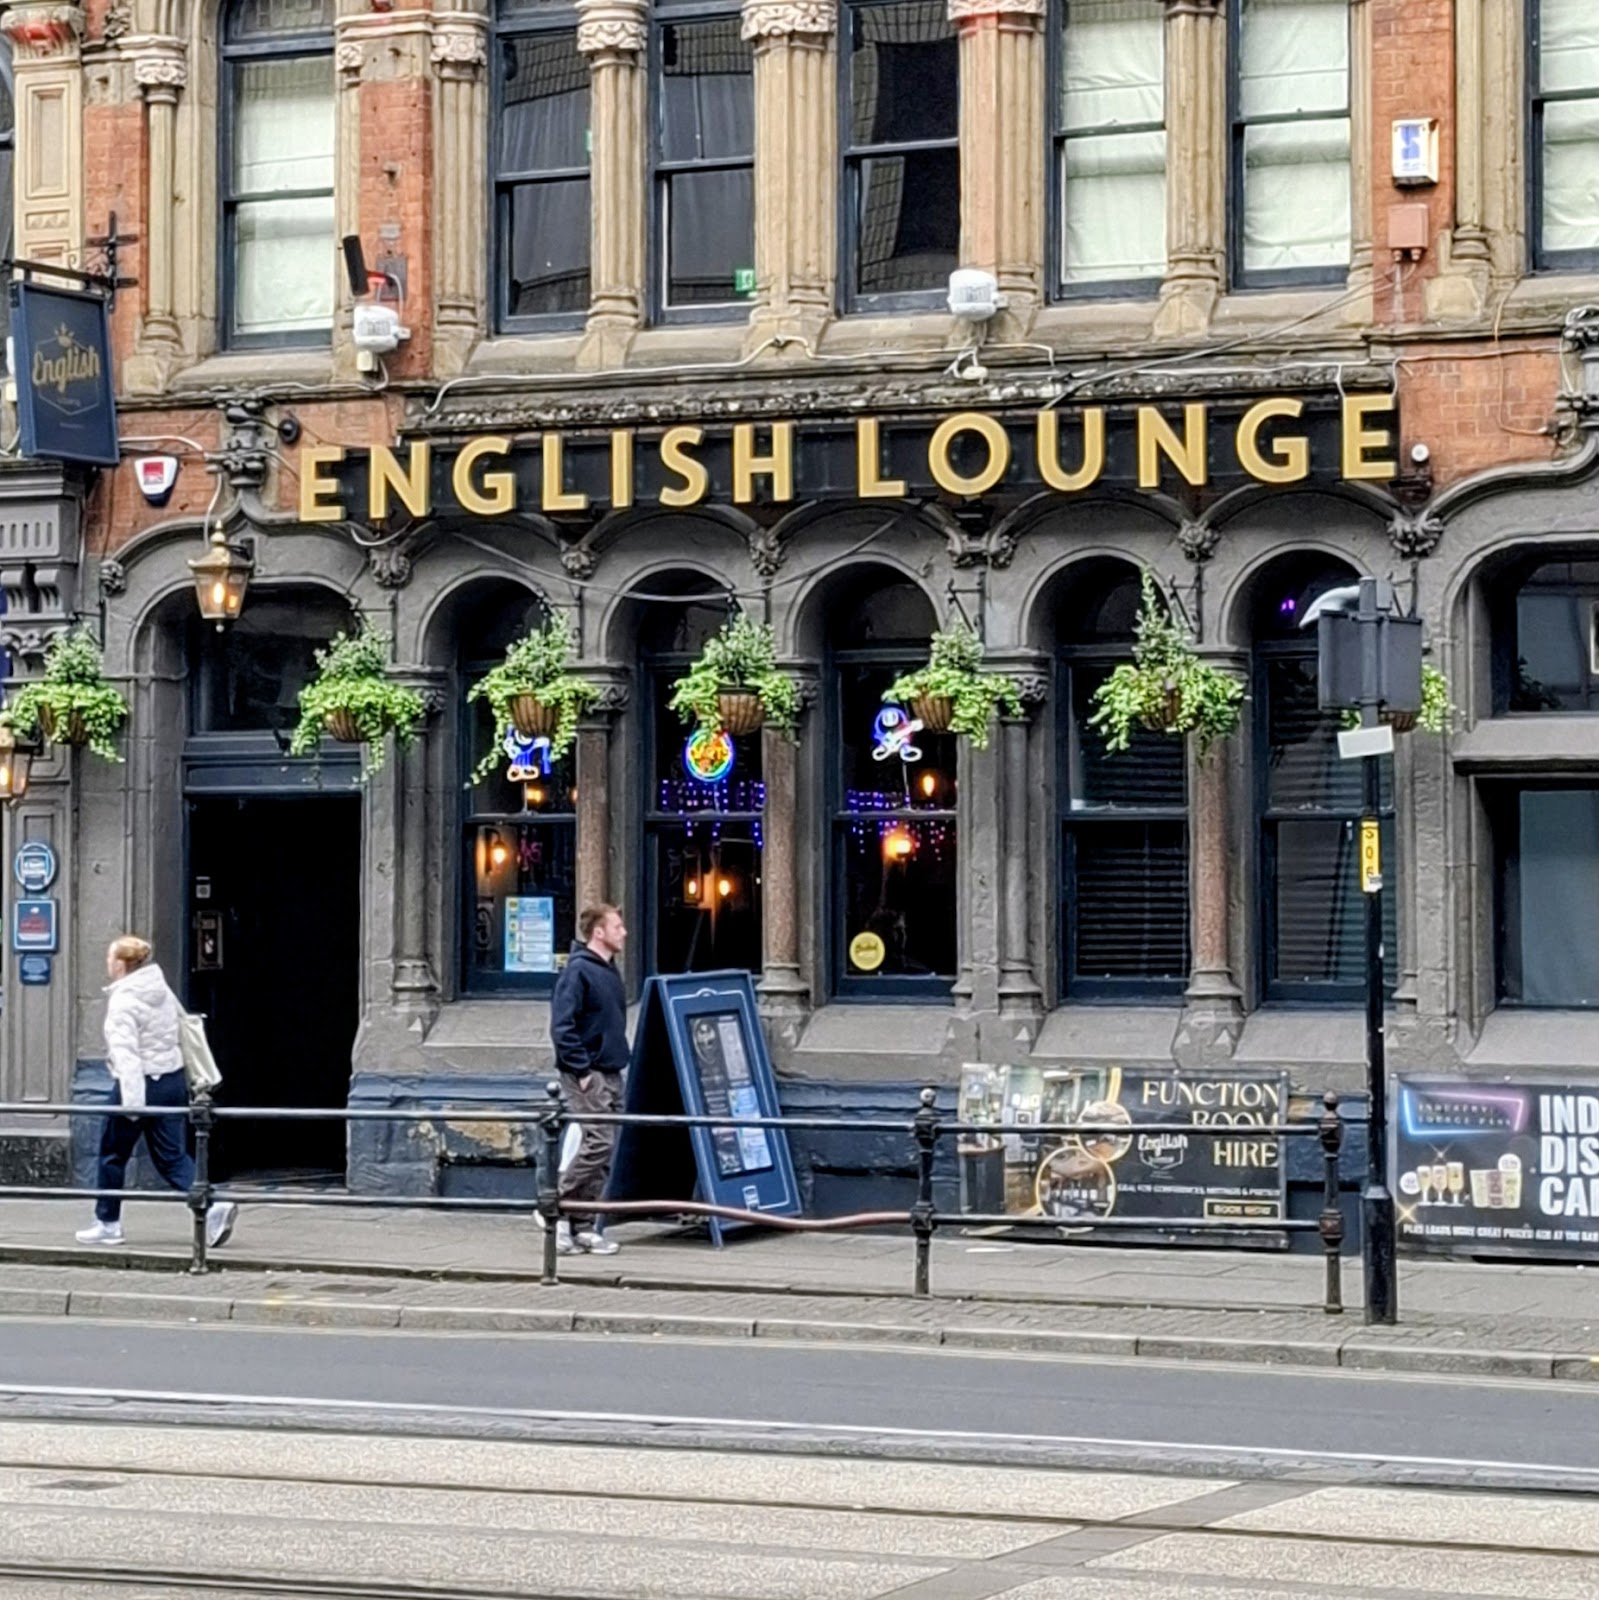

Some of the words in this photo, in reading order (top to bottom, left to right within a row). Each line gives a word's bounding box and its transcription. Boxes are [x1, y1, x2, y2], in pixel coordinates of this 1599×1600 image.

[32, 345, 100, 393] English
[299, 420, 796, 522] ENGLISH
[856, 393, 1397, 498] LOUNGE
[1142, 1080, 1280, 1107] FUNCTION
[1539, 1095, 1599, 1135] IND
[1213, 1141, 1279, 1168] HIRE
[1540, 1135, 1599, 1176] DIS
